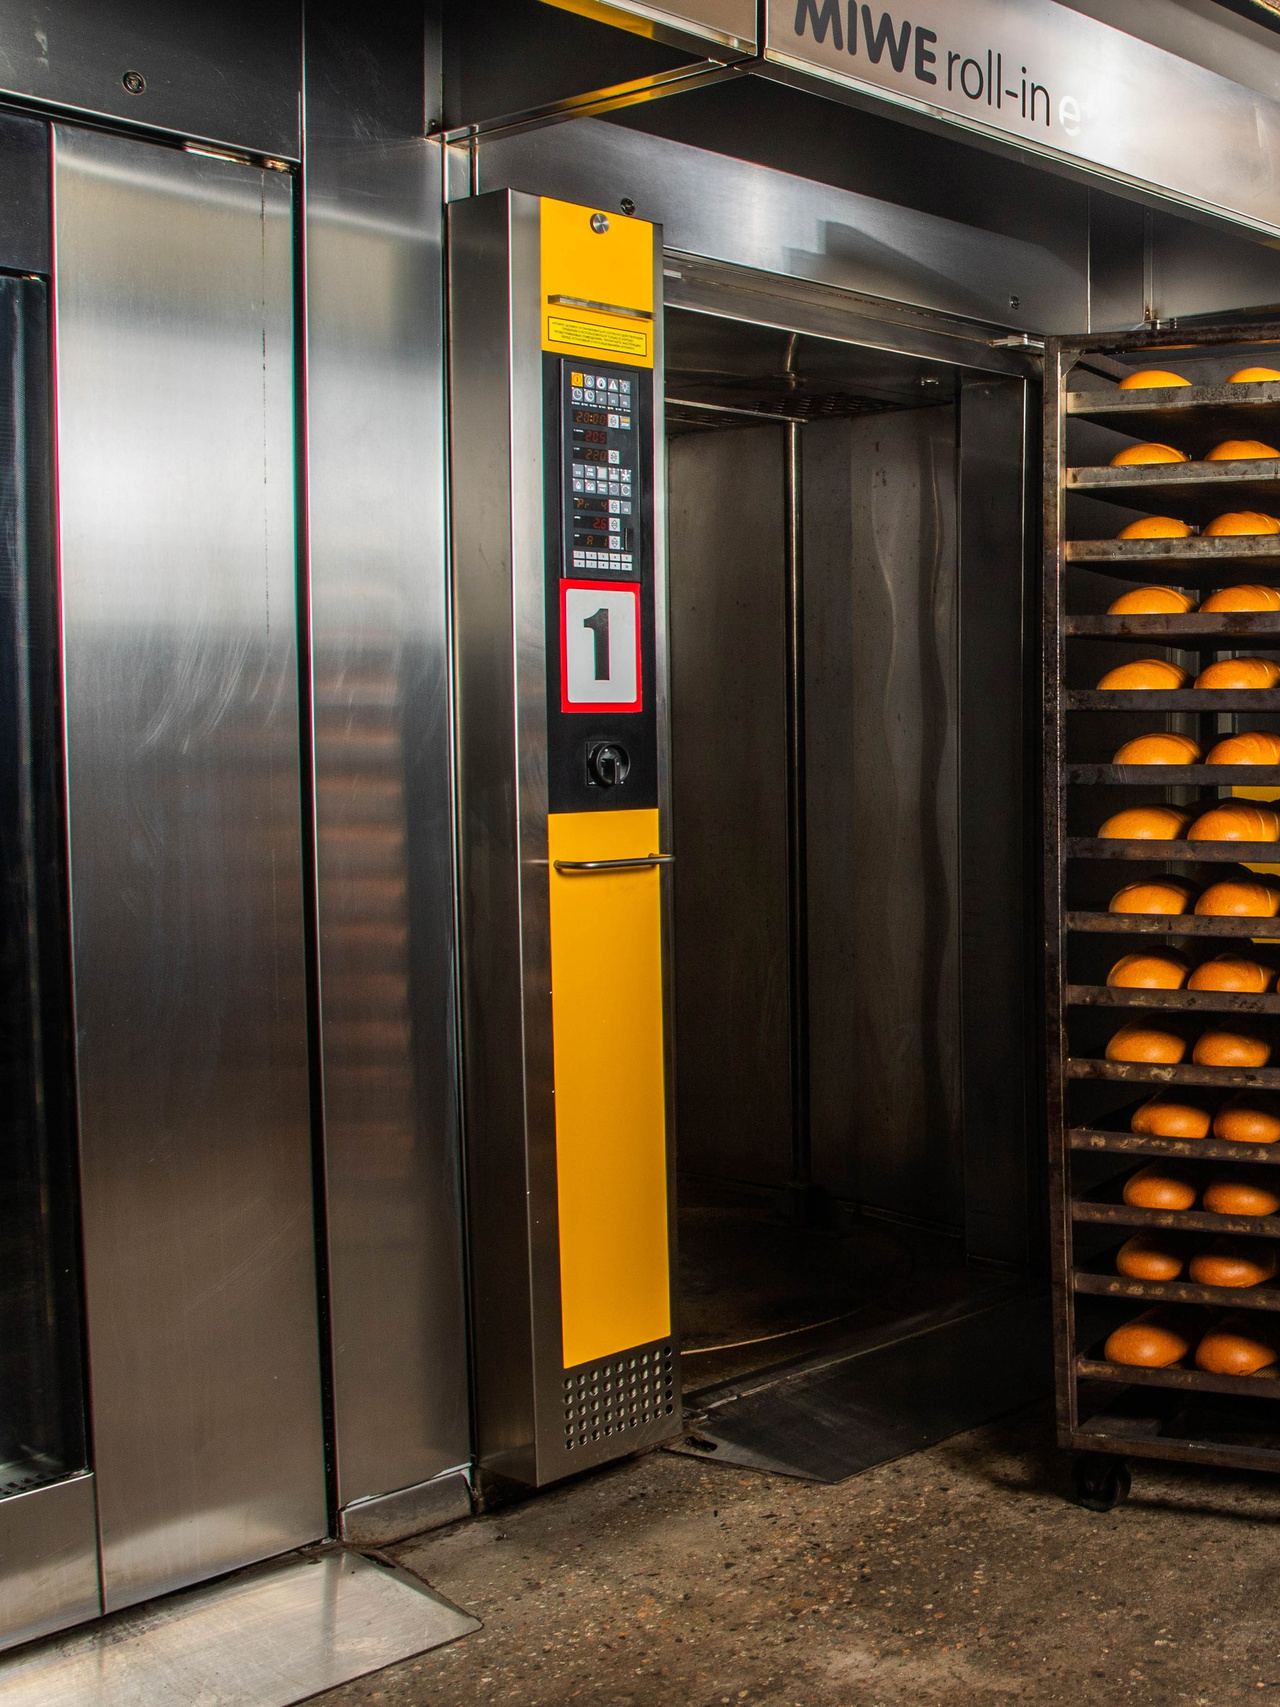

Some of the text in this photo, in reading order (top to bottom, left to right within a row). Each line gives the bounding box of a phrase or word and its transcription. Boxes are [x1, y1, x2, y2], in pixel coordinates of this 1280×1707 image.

[794, 0, 937, 85] MIWE
[948, 49, 1050, 126] roll-in
[583, 608, 610, 680] 1
